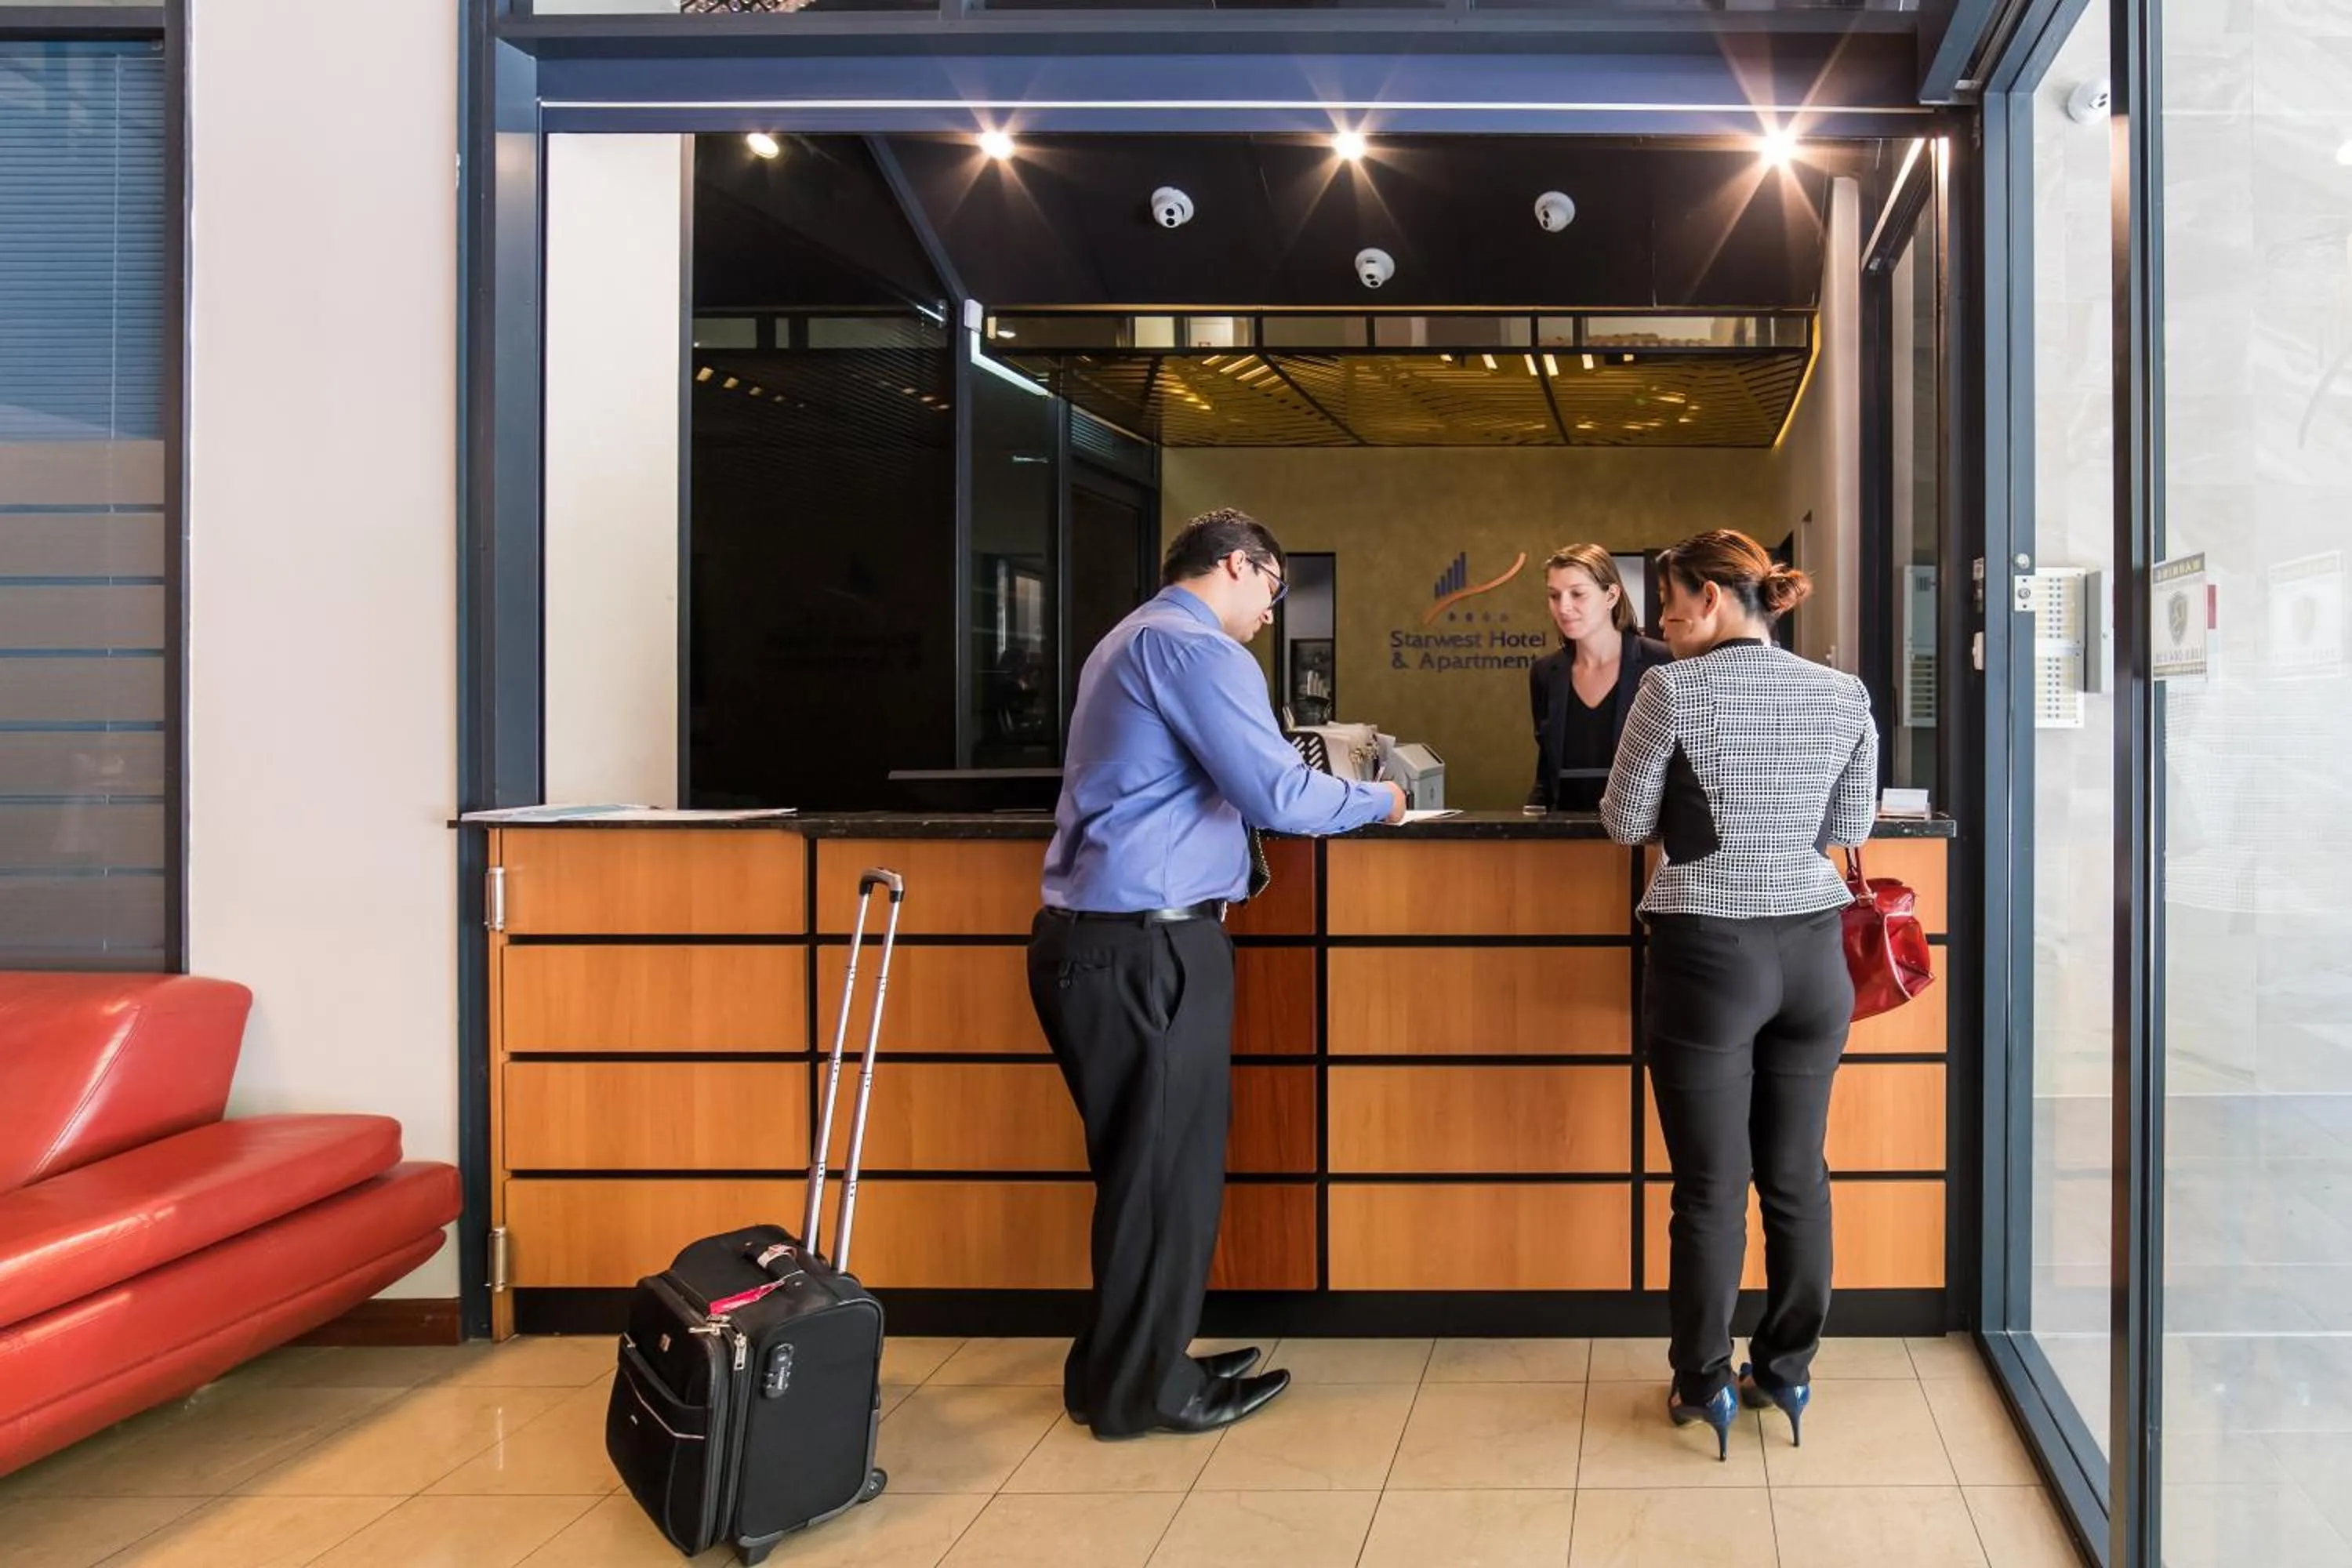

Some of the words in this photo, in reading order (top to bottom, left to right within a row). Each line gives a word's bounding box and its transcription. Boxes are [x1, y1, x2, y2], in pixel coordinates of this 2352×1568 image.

[1390, 630, 1483, 648] Starwest
[1490, 631, 1546, 648] Hotel
[1391, 652, 1410, 670] &
